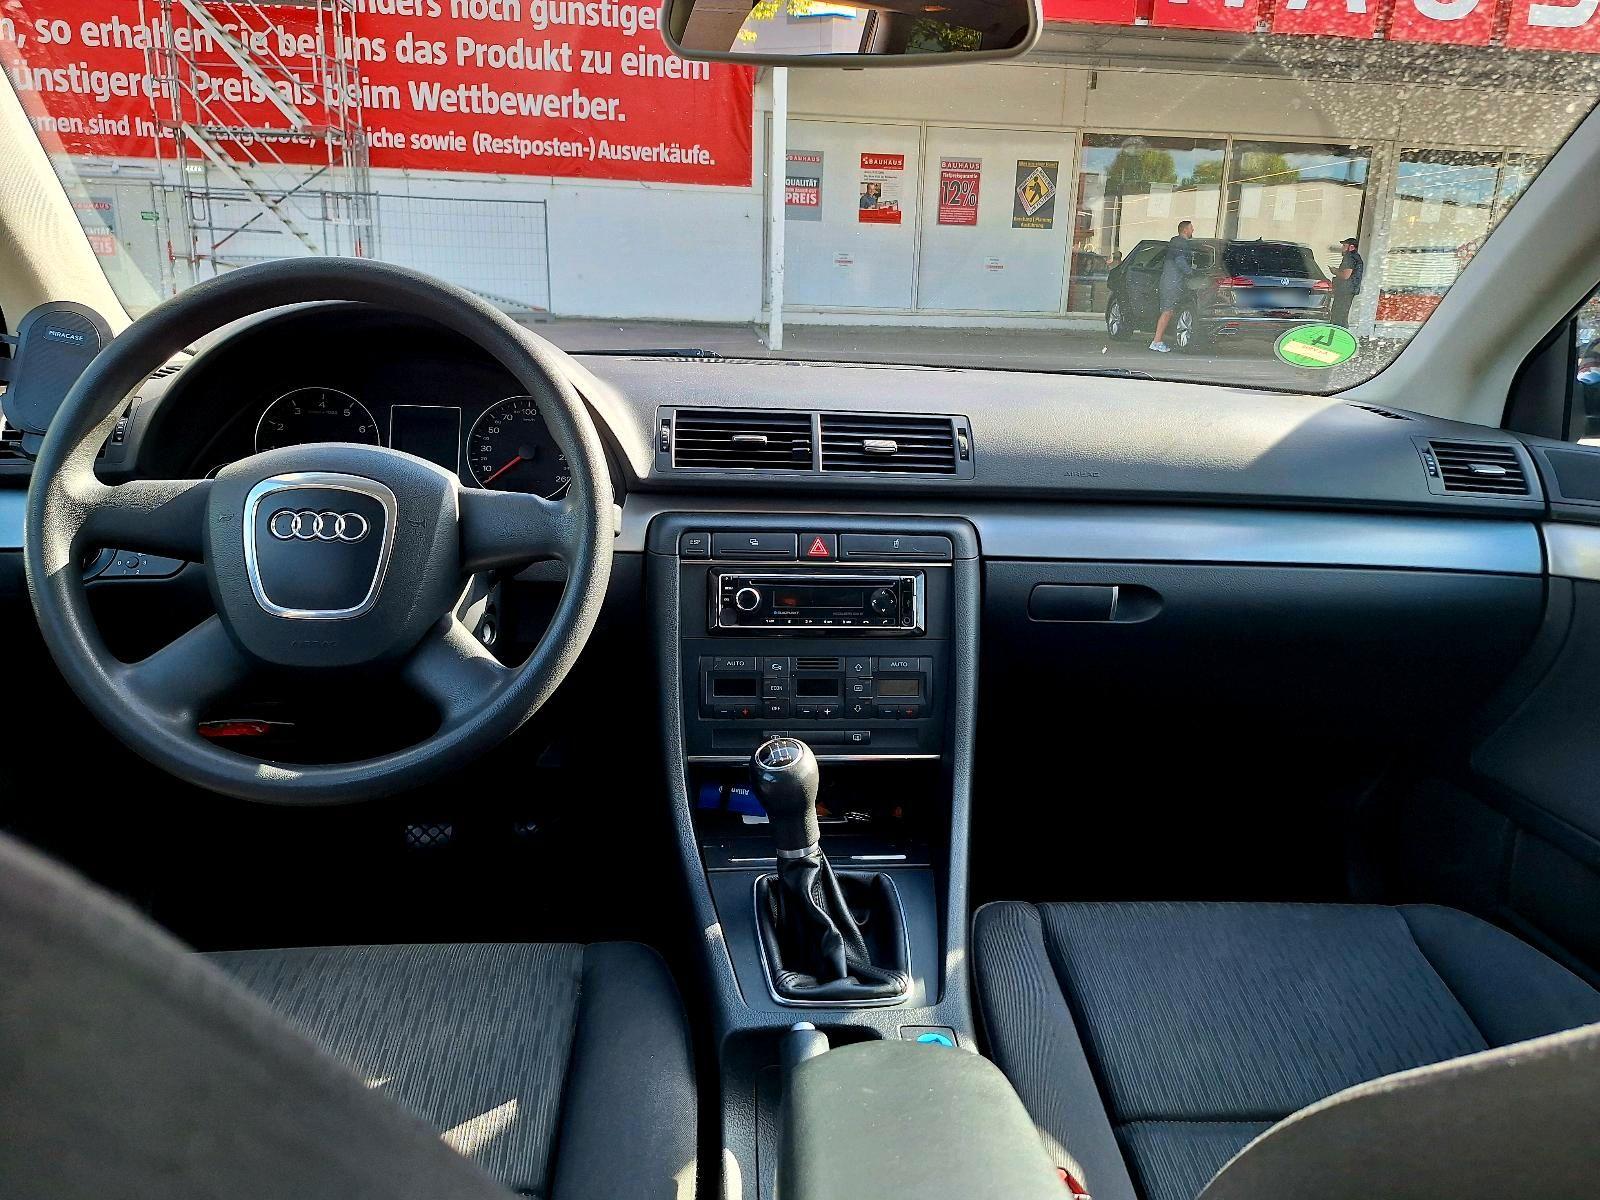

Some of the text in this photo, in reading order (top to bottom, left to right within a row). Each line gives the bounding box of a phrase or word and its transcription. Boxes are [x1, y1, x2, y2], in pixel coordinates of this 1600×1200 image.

[33, 18, 72, 45] so
[395, 31, 448, 66] das
[456, 36, 573, 73] Produkt
[580, 49, 612, 75] zu
[621, 45, 710, 81] einem
[408, 80, 626, 122] Wettbewerber.
[88, 114, 130, 136] sind
[410, 130, 467, 152] sowie
[472, 130, 595, 161] (Restposten-)
[598, 139, 715, 166] Ausverkäufe.
[868, 158, 903, 166] BAUHAUS
[941, 161, 980, 170] BAUHAUS
[785, 178, 817, 187] QUALITÄT
[941, 180, 976, 207] 12%
[785, 192, 817, 205] PREIS
[48, 330, 84, 341] MIRACASE
[343, 408, 351, 417] 5
[521, 408, 537, 416] 100
[502, 413, 513, 421] 70
[276, 423, 284, 431] 2
[358, 425, 366, 433] 6
[488, 426, 500, 434] 50
